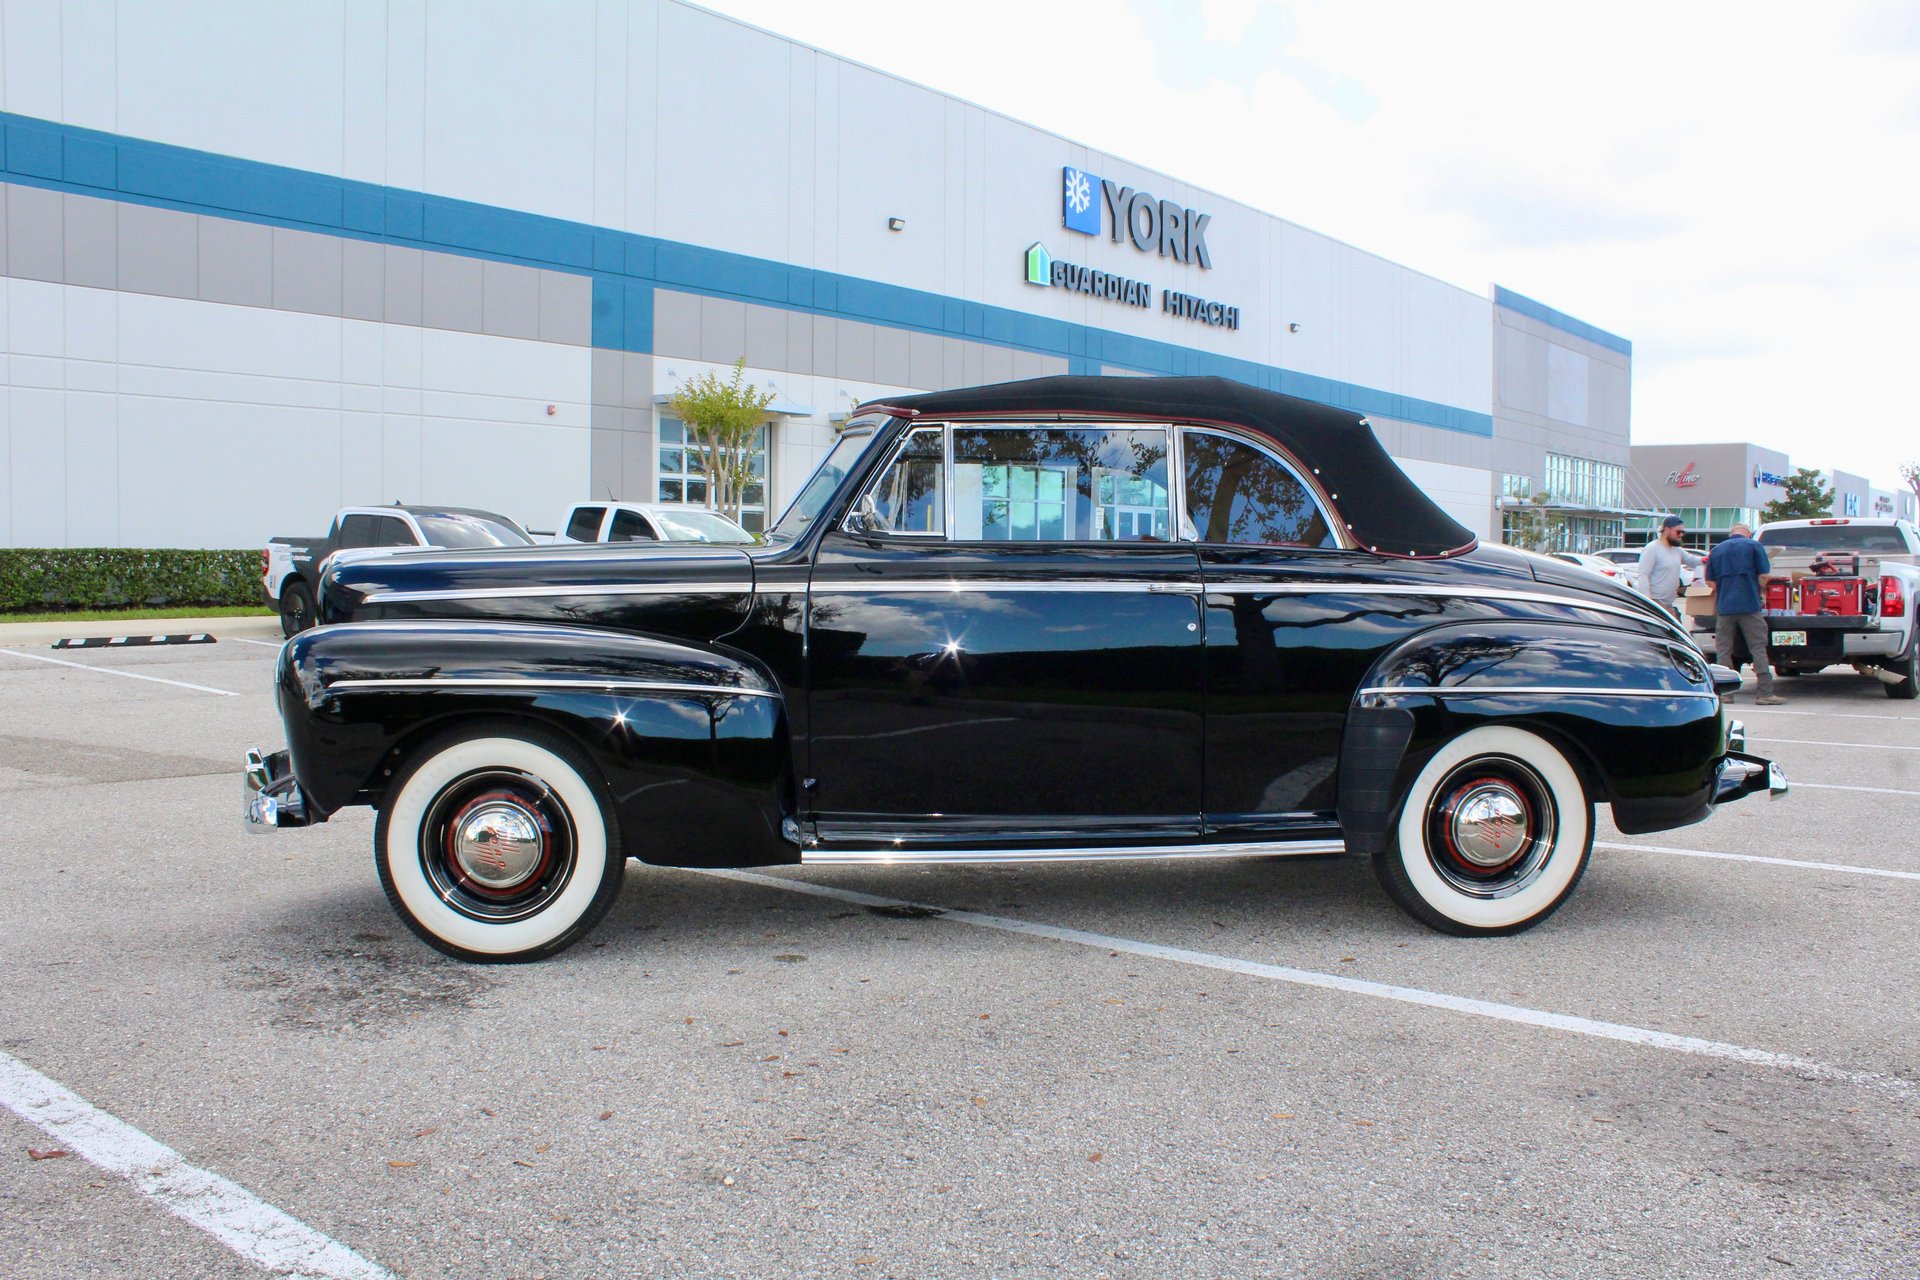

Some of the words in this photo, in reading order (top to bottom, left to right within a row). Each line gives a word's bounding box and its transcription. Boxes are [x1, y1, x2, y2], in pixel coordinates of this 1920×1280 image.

[1101, 179, 1212, 270] YORK
[1050, 260, 1151, 309] GUARDIAN
[1162, 289, 1240, 330] HITACHI
